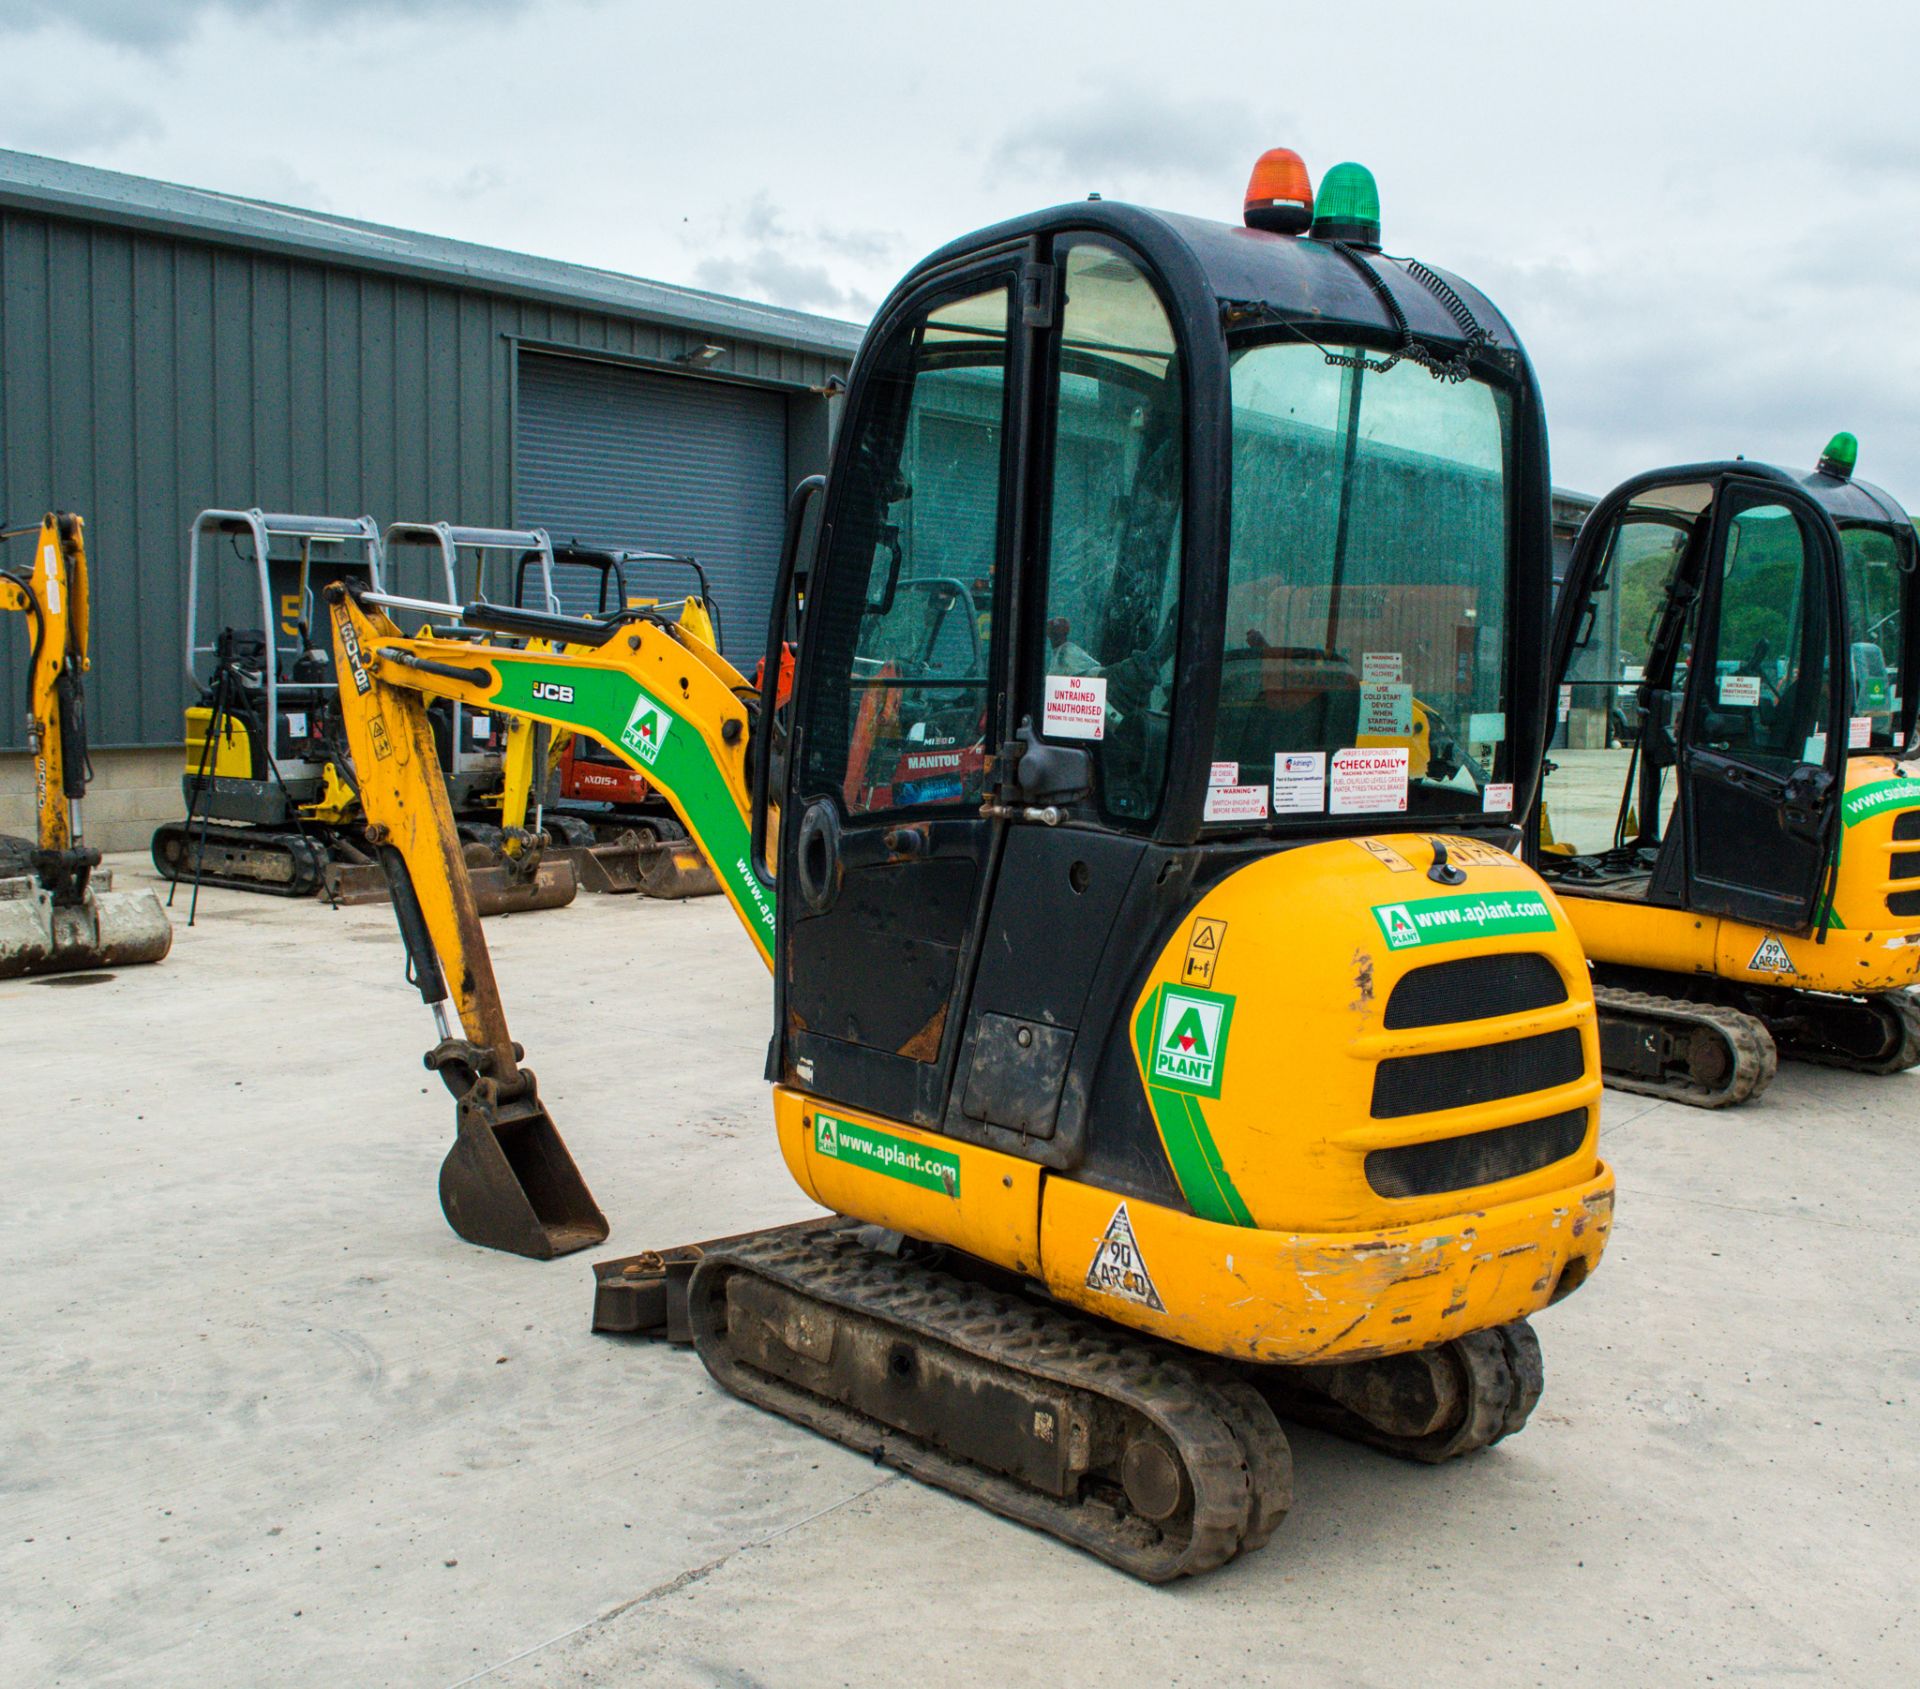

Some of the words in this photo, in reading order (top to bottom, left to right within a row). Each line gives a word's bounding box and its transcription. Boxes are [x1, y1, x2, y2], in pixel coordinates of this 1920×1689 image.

[341, 622, 367, 686] 8018
[533, 682, 574, 703] JCB
[1070, 679, 1081, 689] NO
[1055, 690, 1096, 703] UNTRAINED
[1047, 702, 1102, 716] UNAUTHORISED
[631, 709, 659, 748] A
[623, 730, 657, 762] PLANT
[908, 754, 959, 769] MANITOU
[1340, 760, 1372, 769] CHECK
[1374, 758, 1401, 769] DAILY
[1391, 910, 1412, 932] A
[1414, 901, 1548, 927] www.aplant.com
[1392, 932, 1418, 943] PLANT
[1765, 944, 1780, 955] 99
[1165, 1007, 1210, 1057] A
[1158, 1054, 1212, 1080] PLANT
[839, 1132, 957, 1182] www.aplant.com
